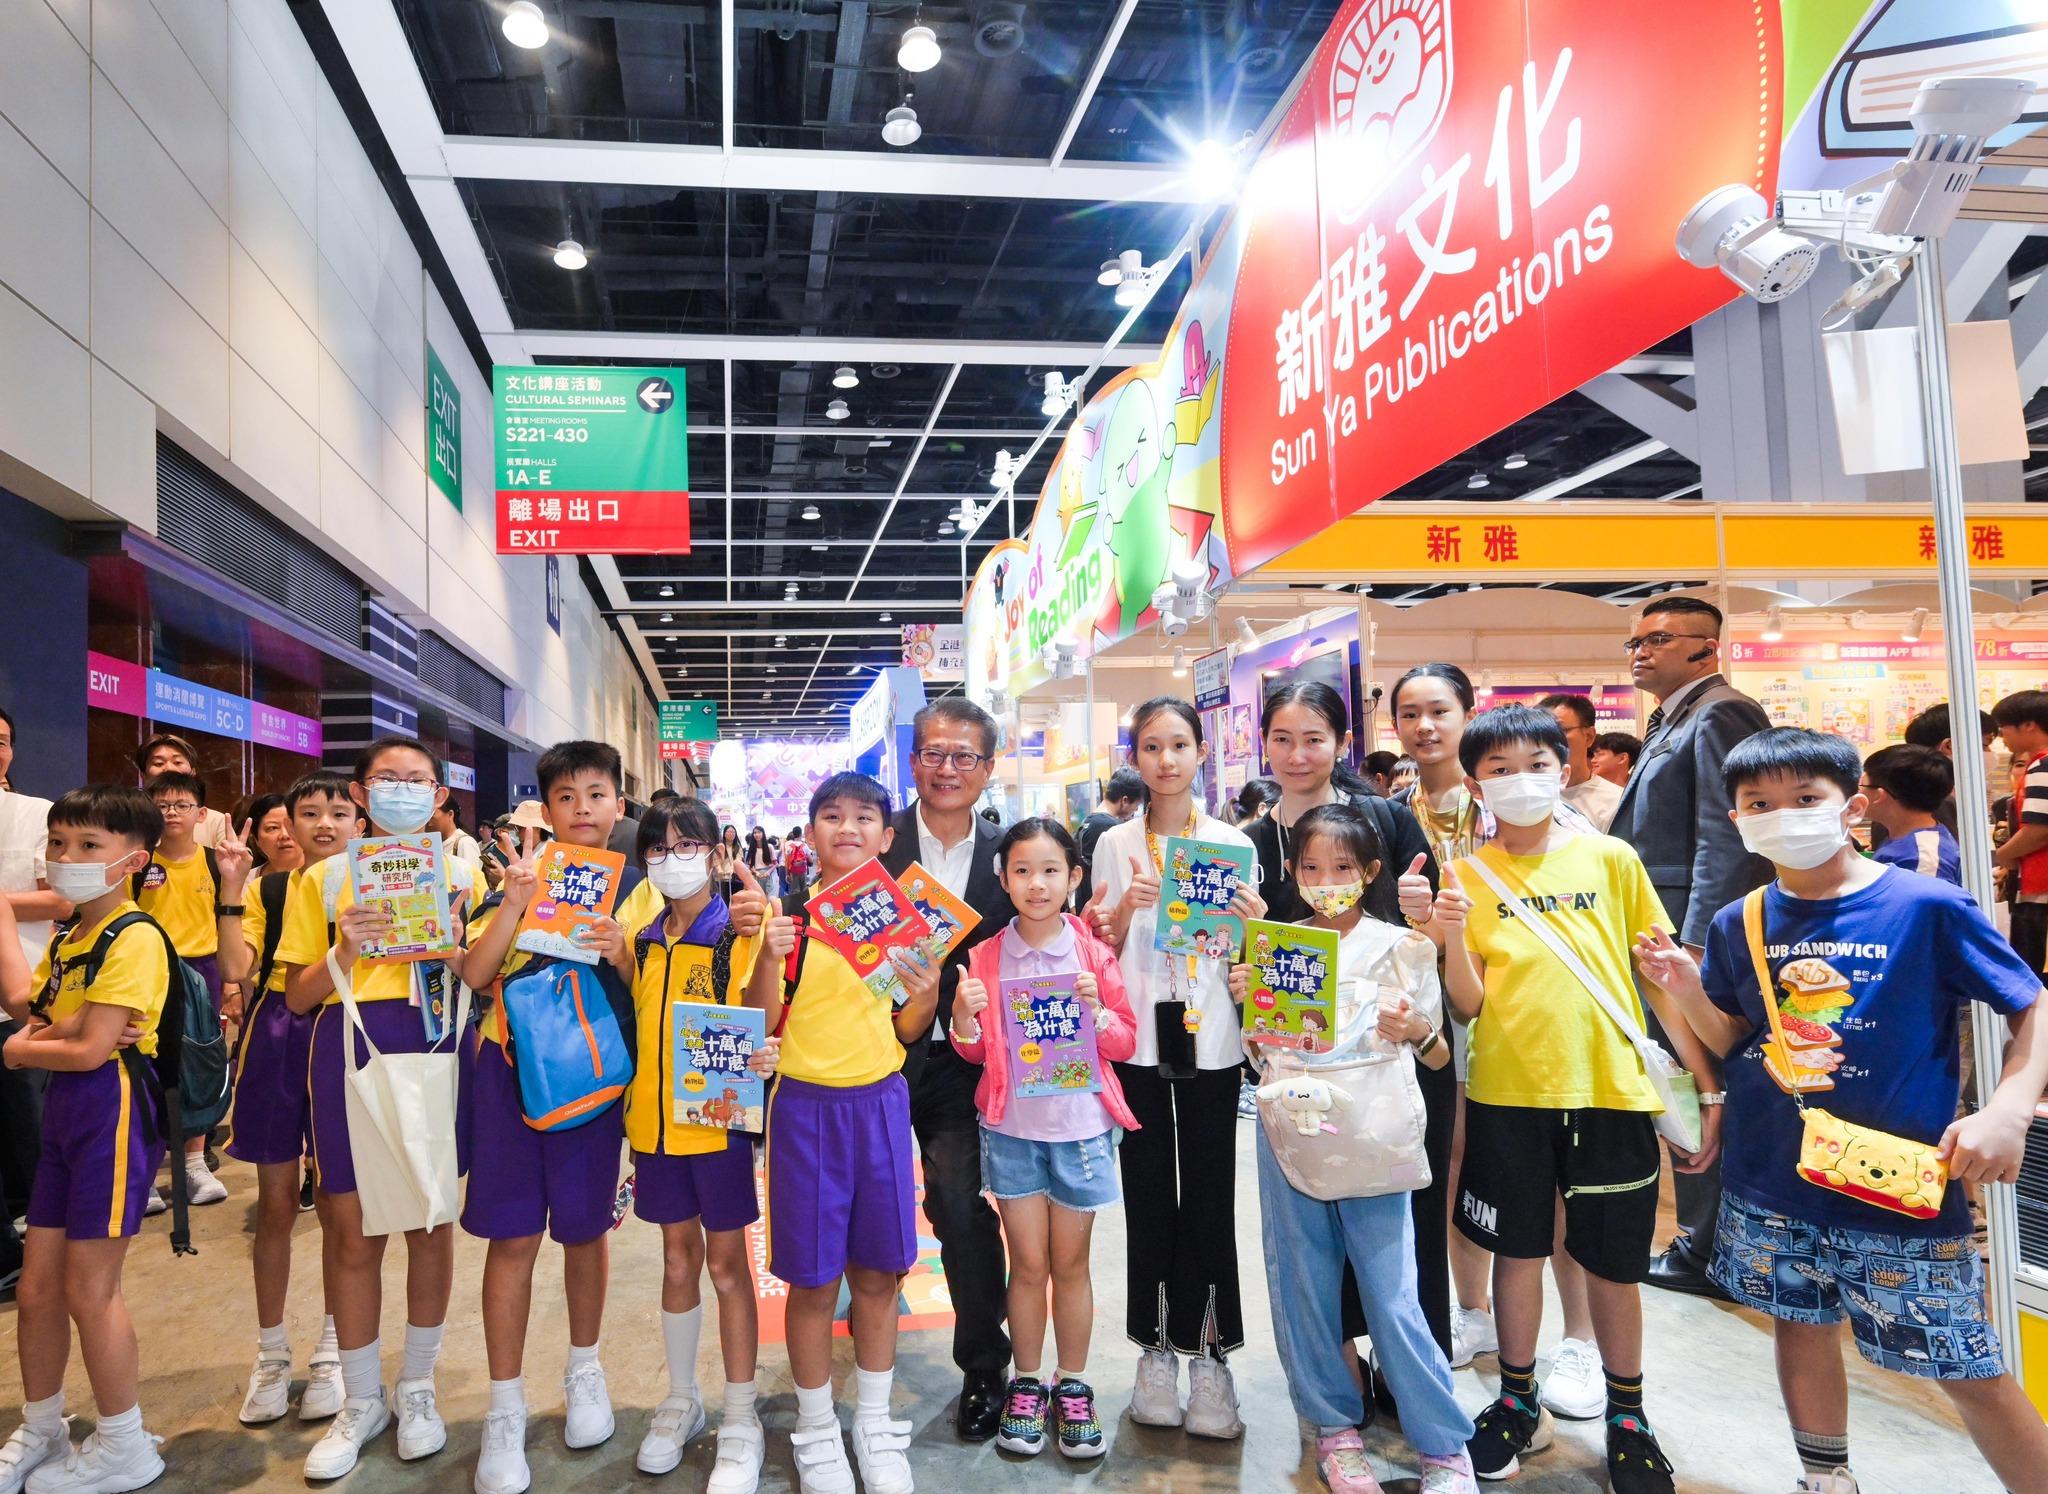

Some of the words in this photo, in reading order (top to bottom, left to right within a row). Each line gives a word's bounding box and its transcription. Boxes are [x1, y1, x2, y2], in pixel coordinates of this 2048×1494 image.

[1274, 47, 1582, 417] 新雅文化
[1270, 417, 1316, 486] Sun
[1322, 392, 1357, 450] Ya
[1365, 203, 1614, 421] Publications
[505, 376, 602, 392] 文化講座活動
[433, 373, 457, 438] EXIT
[505, 394, 566, 406] CULTURAL
[567, 395, 627, 407] SEMINARS
[530, 417, 561, 425] MEETING
[506, 428, 588, 443] S221-430
[435, 423, 457, 486] 出口
[506, 470, 552, 485] 1A-E
[508, 498, 620, 522] 離場出口
[510, 530, 560, 547] EXIT
[1426, 525, 1520, 563] 新雅
[1028, 547, 1103, 660] Reading
[1889, 647, 1910, 657] APP
[90, 670, 120, 695] EXIT
[216, 710, 244, 732] 5C-D
[297, 731, 309, 748] 5B
[662, 730, 684, 739] 1A-E
[371, 858, 421, 873] 奇妙科學
[382, 872, 412, 883] 研究所
[565, 870, 609, 893] 十萬個
[1192, 868, 1239, 889] 十萬個
[548, 881, 597, 905] 為什麼
[1178, 880, 1229, 904] 為什麼
[850, 890, 894, 921] 十萬個
[846, 905, 897, 942] 為什麼
[1764, 944, 1790, 959] LUB
[1791, 942, 1888, 959] SANDWICH
[1276, 954, 1326, 978] 十萬個
[1262, 965, 1316, 994] 為什麼
[1034, 1001, 1080, 1021] 十萬個
[1024, 1019, 1076, 1038] 為什麼
[705, 1034, 753, 1056] 十萬個
[691, 1048, 746, 1072] 為什麼
[1857, 1069, 1869, 1077] x1
[1630, 1180, 1649, 1189] VACATION
[1463, 1189, 1497, 1231] FUN
[1937, 1241, 1960, 1253] LOOK!
[1873, 1270, 1907, 1283] LOOK!
[1874, 1279, 1898, 1288] LOOK!
[1960, 1325, 1974, 1335] OH!
